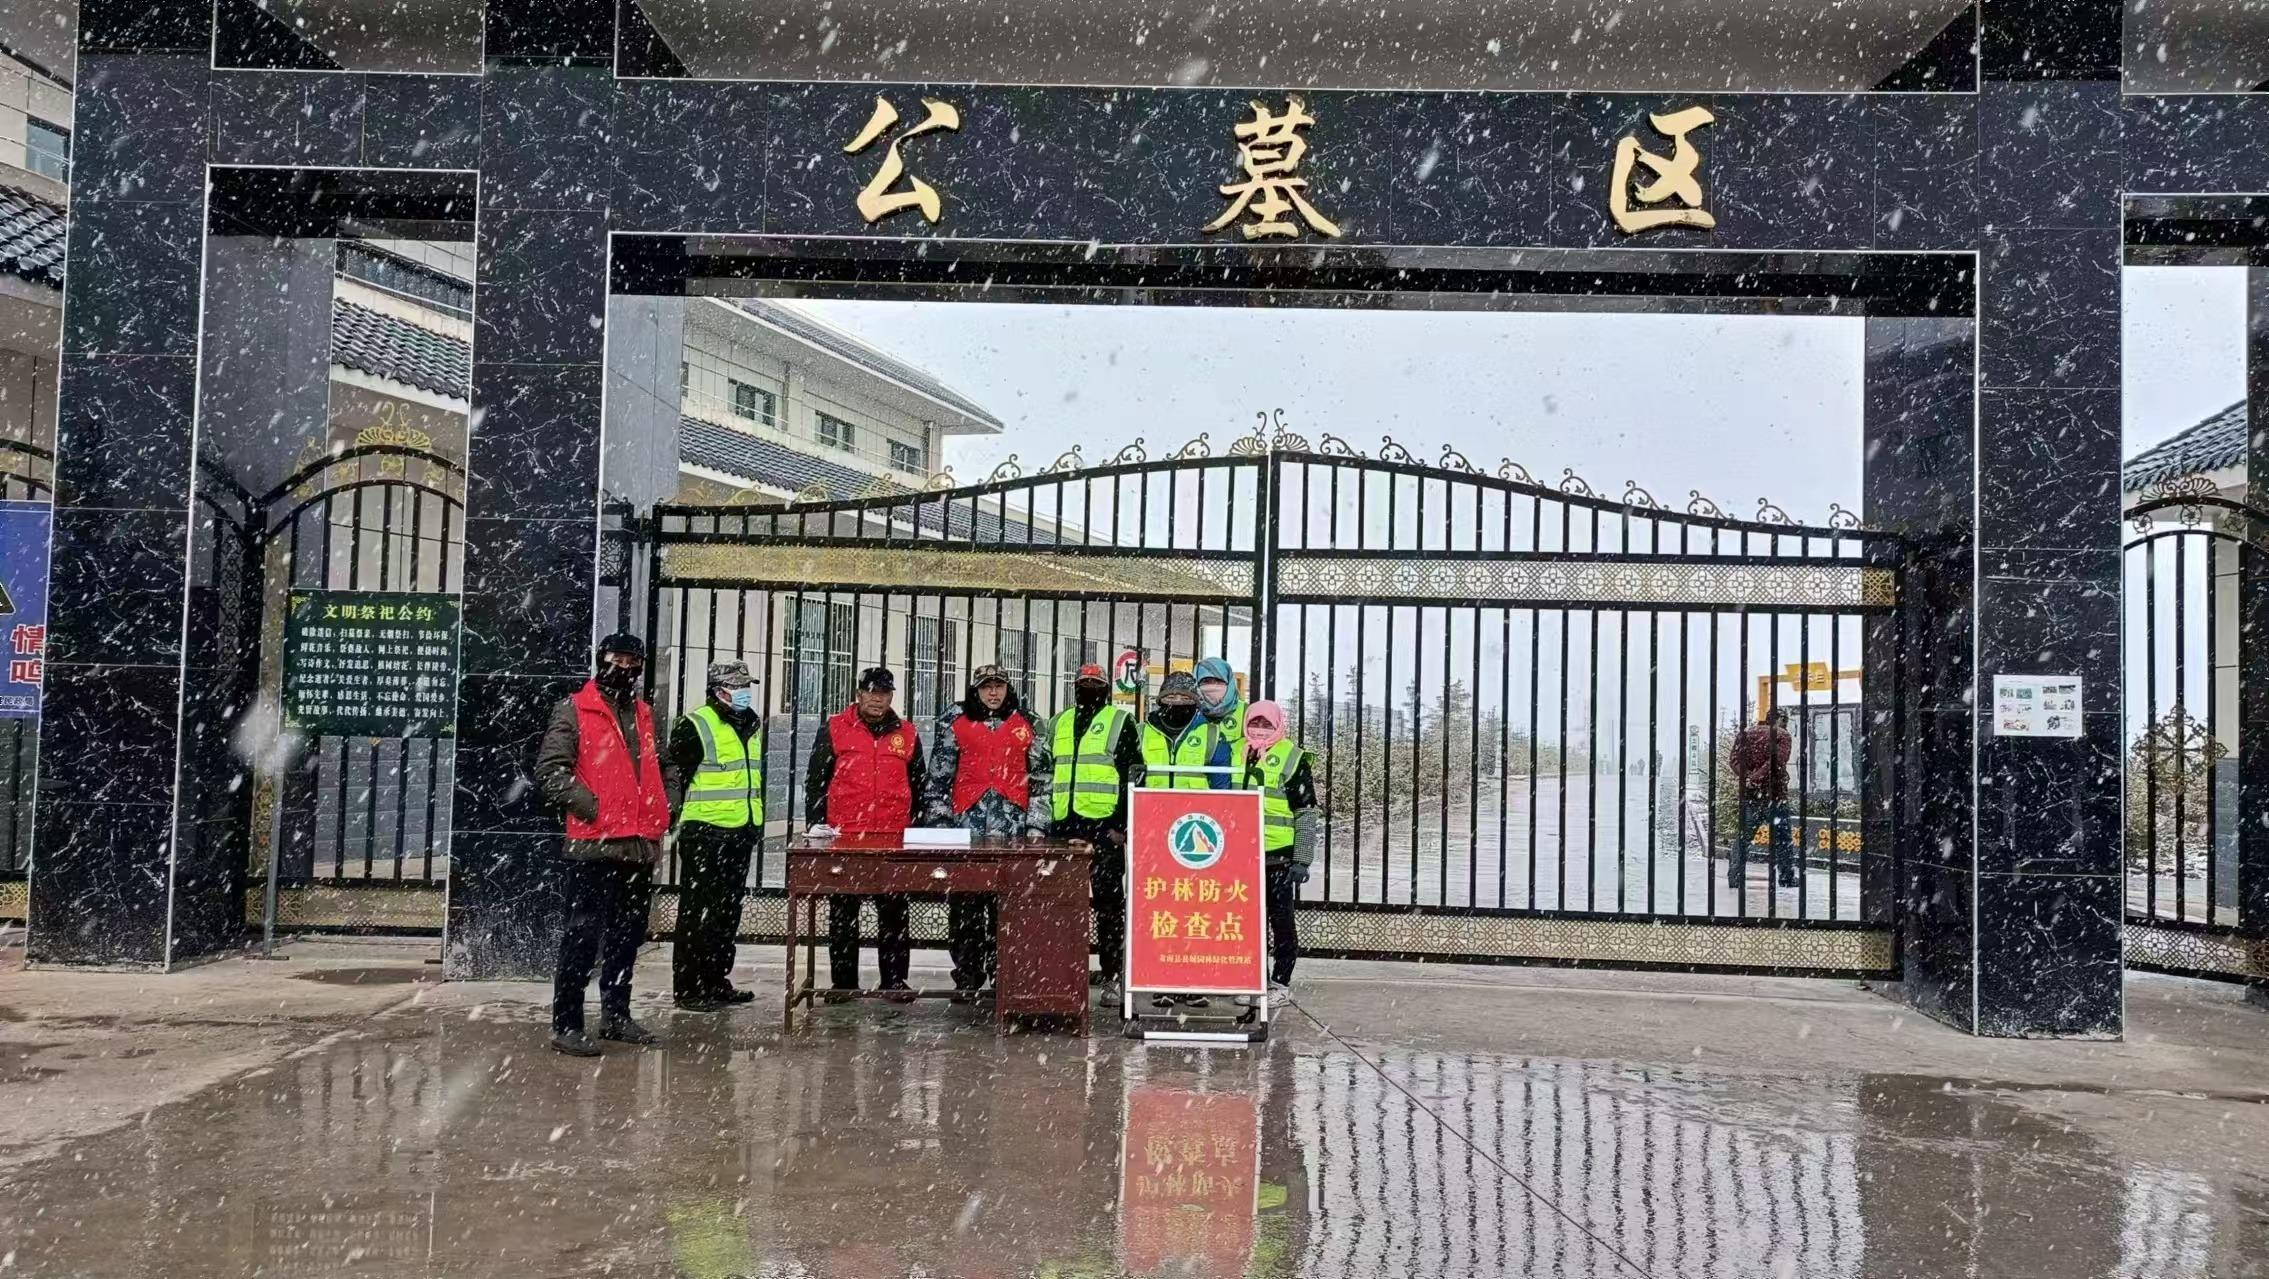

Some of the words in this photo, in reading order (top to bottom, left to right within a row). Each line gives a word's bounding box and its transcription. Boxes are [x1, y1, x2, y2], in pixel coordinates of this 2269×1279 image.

[845, 98, 1716, 239] 公墓区
[323, 604, 432, 621] 文明祭祀公约
[1143, 877, 1249, 902] 护林防火
[1150, 910, 1244, 941] 检查点
